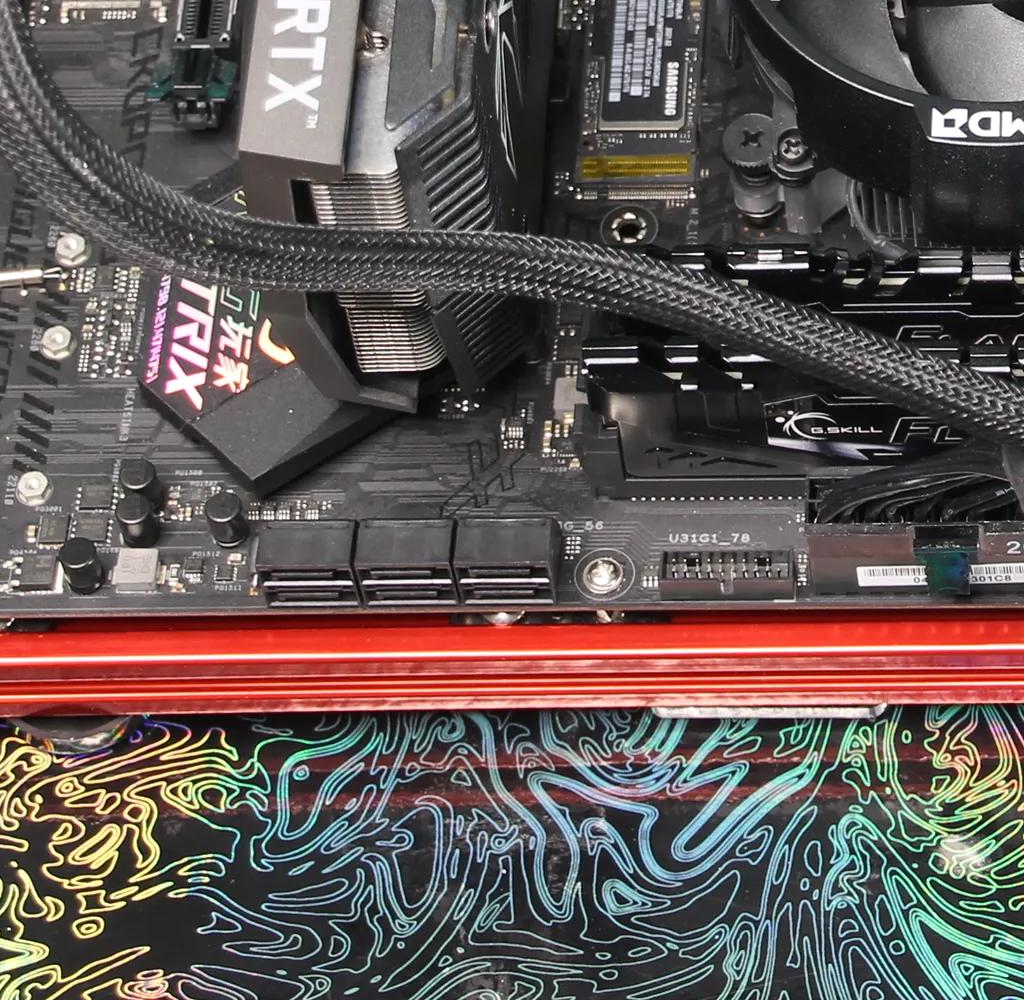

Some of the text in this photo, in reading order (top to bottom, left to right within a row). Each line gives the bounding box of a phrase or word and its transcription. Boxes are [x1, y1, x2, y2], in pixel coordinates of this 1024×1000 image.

[664, 62, 680, 116] SAMSUNG
[164, 278, 217, 411] TRIX
[811, 426, 883, 435] G.SKILL
[4, 474, 18, 505] 22110
[669, 533, 751, 545] U31G1_78
